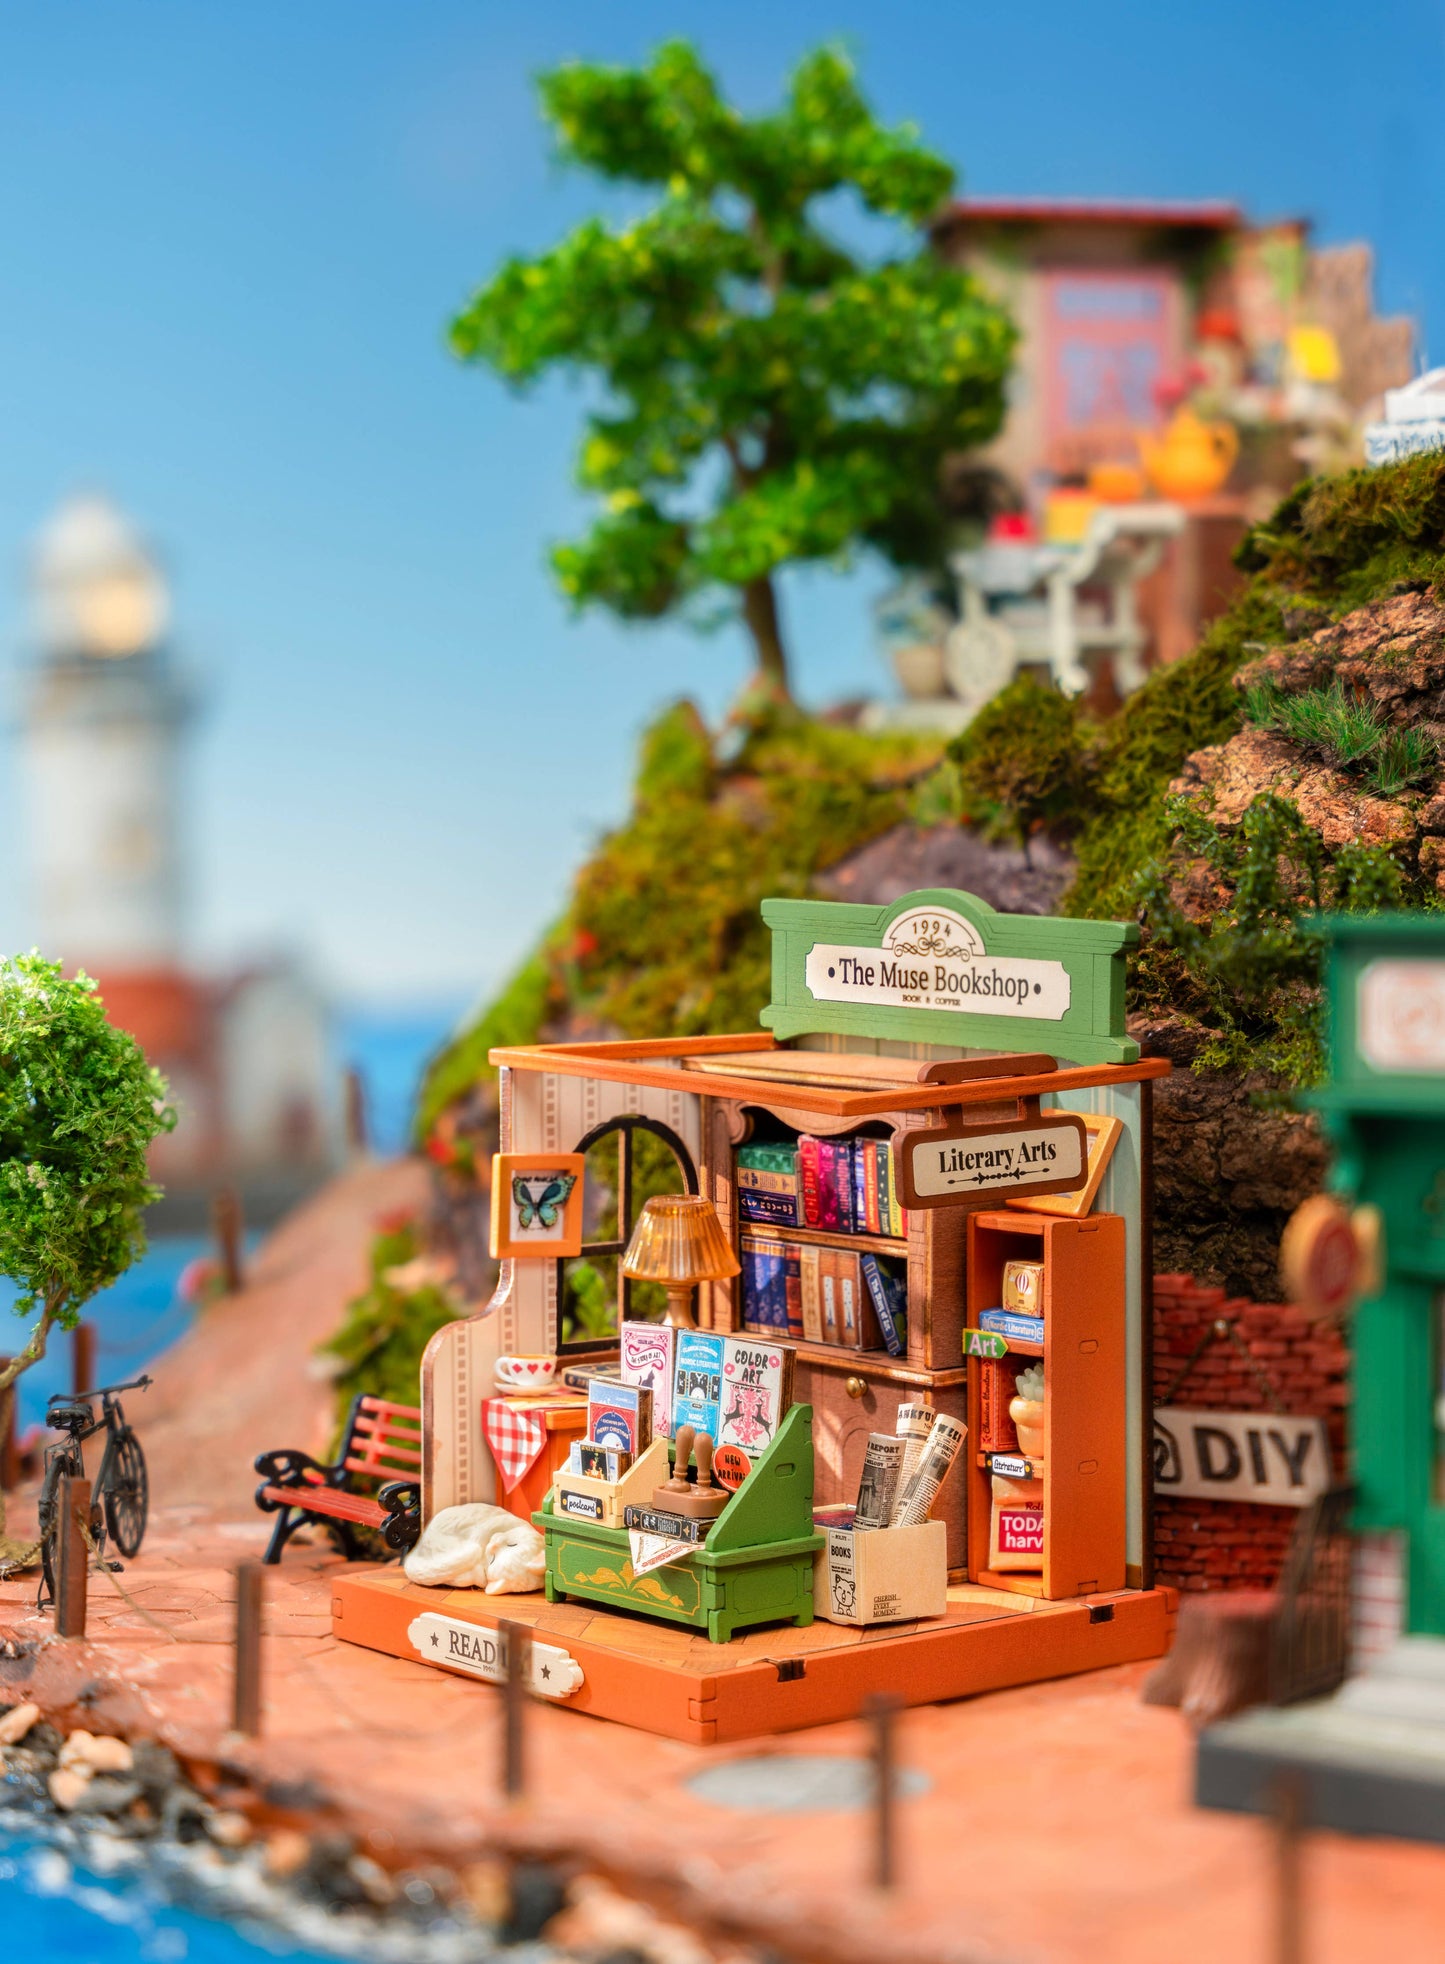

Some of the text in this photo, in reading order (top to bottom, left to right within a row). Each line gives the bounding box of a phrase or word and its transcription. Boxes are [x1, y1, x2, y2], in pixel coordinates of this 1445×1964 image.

[912, 919, 952, 937] 1994
[838, 957, 1029, 1005] The Muse Bookshop
[902, 994, 921, 1004] BOOK
[938, 1140, 1057, 1173] Literary Arts
[968, 1333, 997, 1357] Art
[734, 1349, 769, 1370] COLOR
[742, 1367, 763, 1385] ART
[870, 1442, 900, 1454] REPORT
[724, 1454, 741, 1466] NEW
[1192, 1426, 1313, 1487] DIY
[568, 1498, 597, 1513] postcard
[830, 1545, 852, 1559] BOOKS
[873, 1594, 897, 1603] CHERISH
[873, 1602, 890, 1611] EVERY
[873, 1608, 897, 1617] MOMENT
